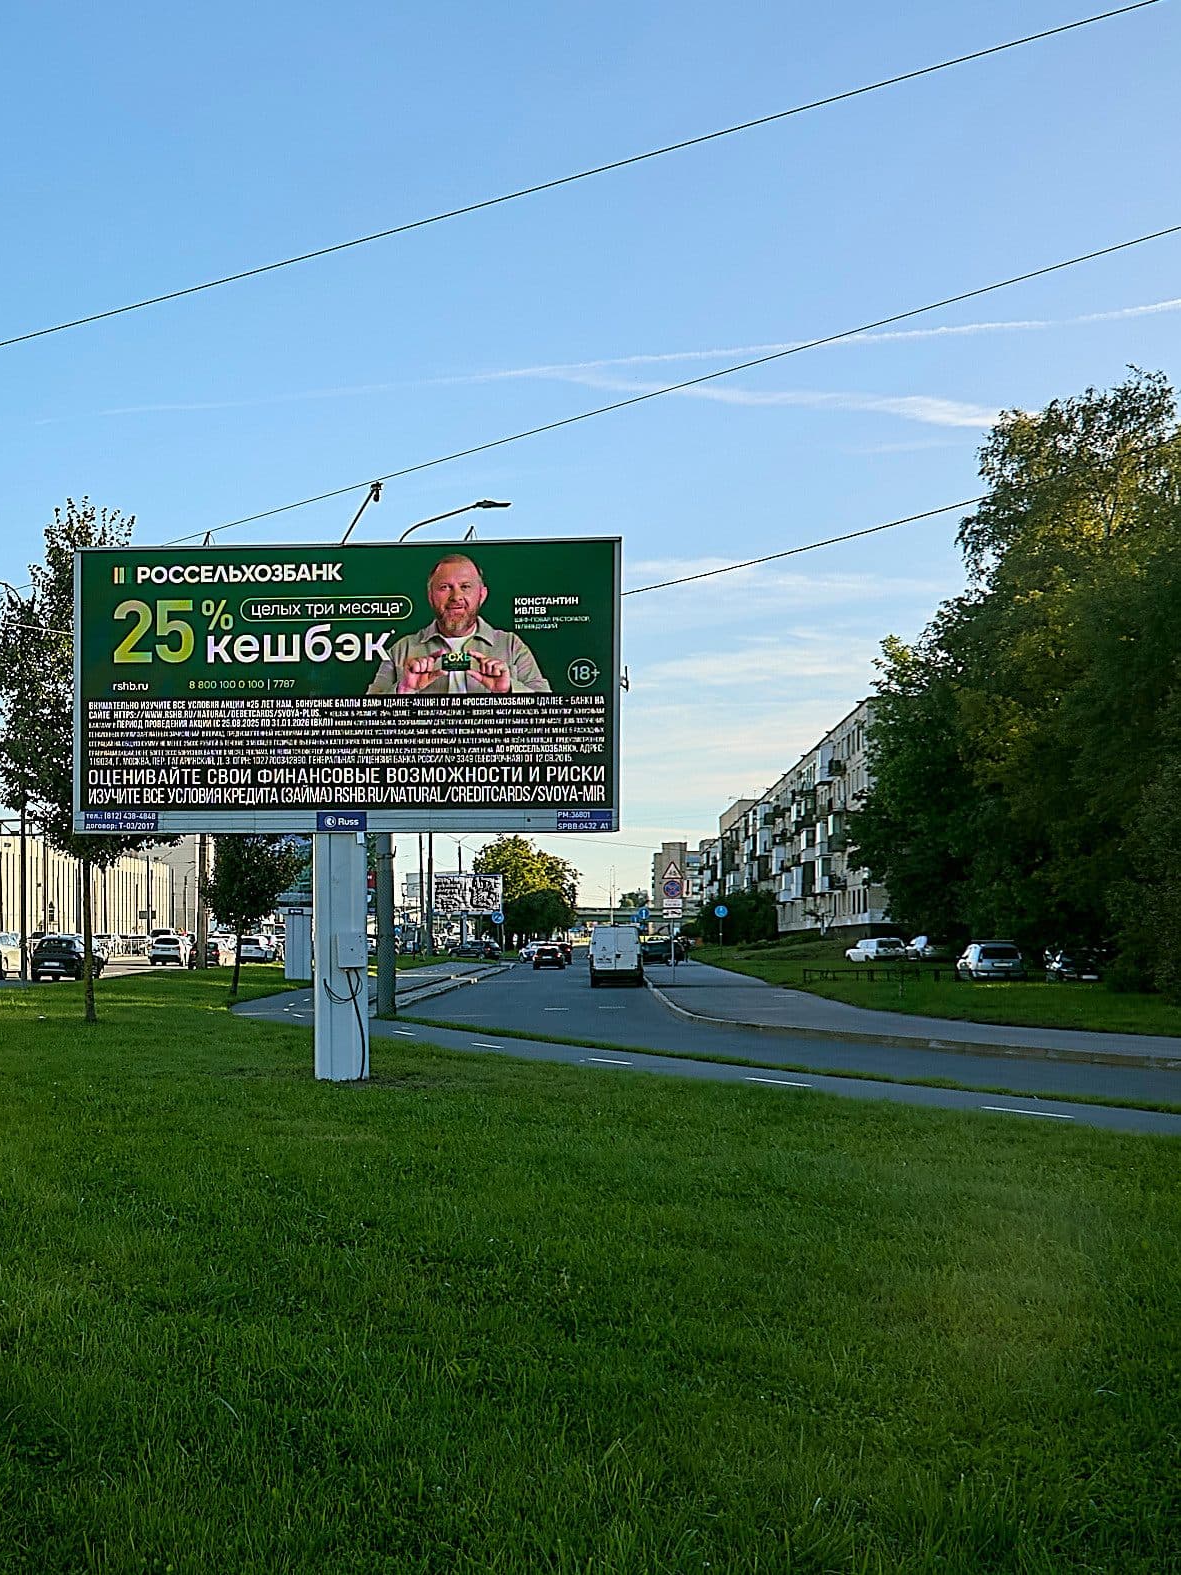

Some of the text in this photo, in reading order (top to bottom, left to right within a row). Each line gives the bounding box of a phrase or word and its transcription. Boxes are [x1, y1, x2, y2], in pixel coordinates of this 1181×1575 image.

[137, 563, 343, 584] РОССЕЛЬХОЗБАНК
[514, 596, 579, 606] КОНСТАНТИН
[251, 604, 301, 618] целых
[305, 603, 334, 617] три
[514, 606, 547, 615] ИВЛЕВ
[571, 665, 601, 681] 18+
[112, 681, 149, 691] rshb.ru
[189, 680, 195, 689] 8
[197, 680, 217, 689] 800
[219, 680, 236, 689] 100
[248, 680, 265, 689] 100
[273, 679, 296, 688] 7787
[140, 701, 171, 710] ИЗУЧИТЕ
[173, 701, 186, 709] ВСЕ
[261, 700, 274, 709] ЛЕТ
[295, 699, 333, 708] БОНУСНЫЕ
[335, 698, 360, 708] БАЛЛЫ
[440, 698, 450, 707] ОТ
[88, 710, 111, 720] САЙТЕ
[116, 720, 144, 730] ПЕРИОД
[144, 719, 188, 729] ПРОВЕДЕНИЯ
[189, 719, 212, 729] АКЦИИ
[88, 765, 605, 786] ОЦЕНИВАЙТЕ СВОИ ФИНАНСОВЫЕ ВОЗМОЖНОСТИ И РИСКИ
[88, 788, 141, 805] ИЗУЧИТЕ
[143, 788, 165, 804] ВСЕ
[167, 787, 221, 804] УСЛОВИЯ
[224, 787, 279, 805] КРЕДИТА
[281, 785, 333, 805] (ЗАЙМА)
[104, 811, 122, 820] (812)
[337, 817, 360, 826] Russ
